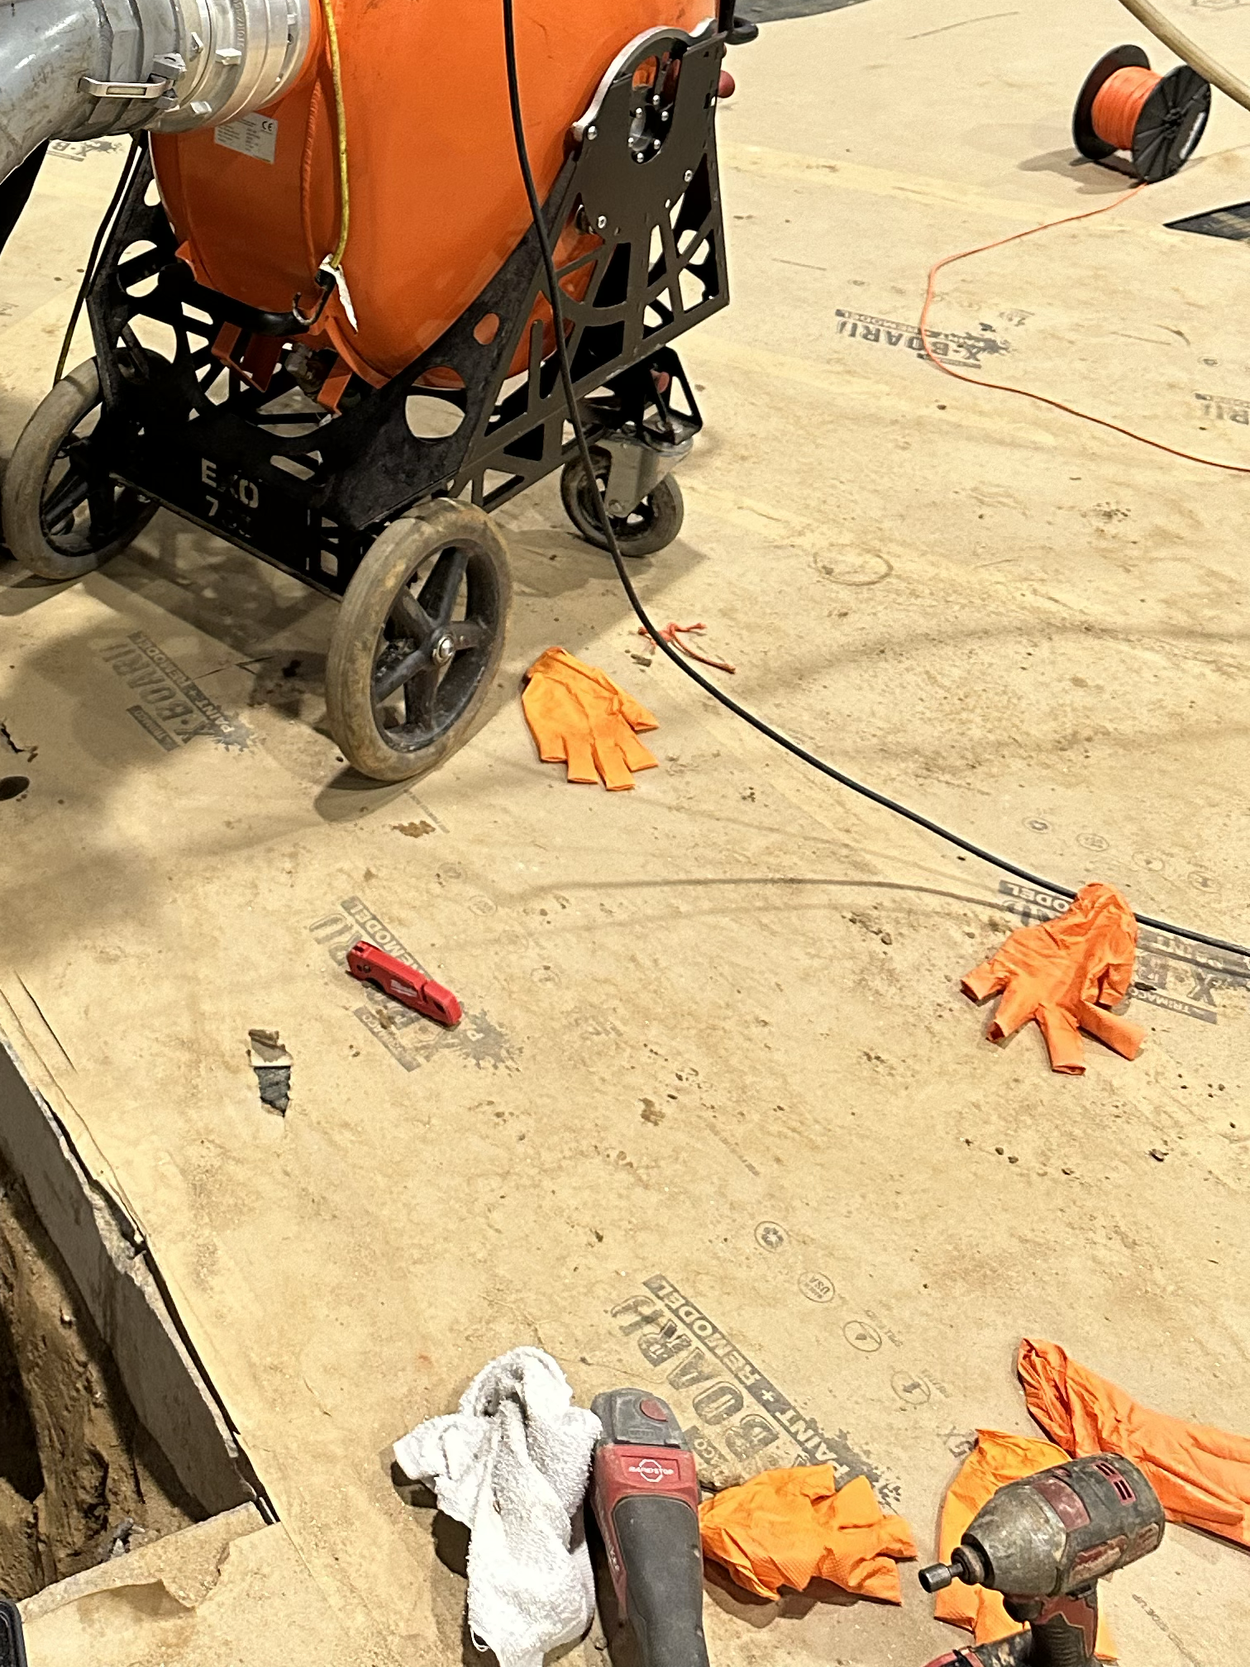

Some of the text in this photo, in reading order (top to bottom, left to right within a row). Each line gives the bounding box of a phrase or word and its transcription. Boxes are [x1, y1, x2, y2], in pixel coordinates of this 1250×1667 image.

[133, 634, 190, 688] REMODEL
[194, 698, 235, 733] PAINT
[1005, 882, 1071, 913] ODEL
[807, 1273, 830, 1297] USA
[652, 1279, 761, 1387] REMODEL
[774, 1404, 850, 1479] PAINT
